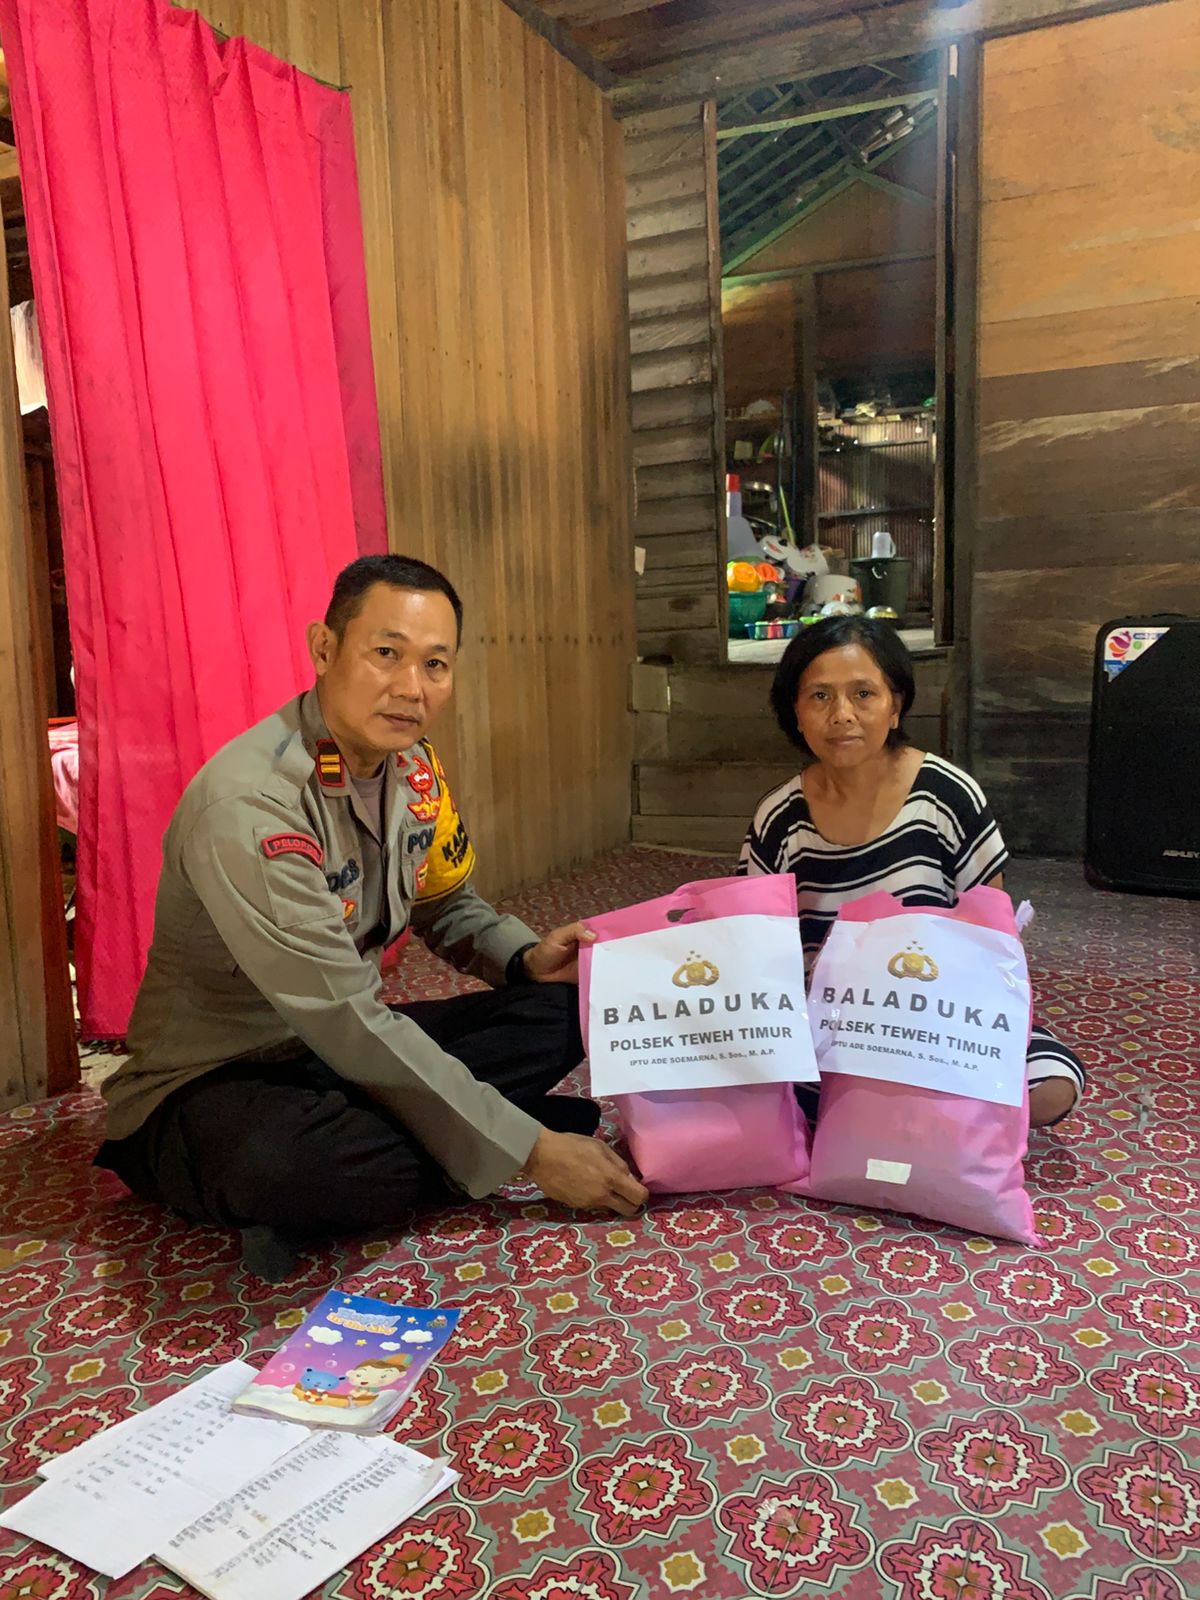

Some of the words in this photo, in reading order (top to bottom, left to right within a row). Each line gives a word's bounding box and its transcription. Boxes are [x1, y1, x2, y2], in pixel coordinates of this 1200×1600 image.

[603, 992, 795, 1025] BALADUKA
[823, 987, 1011, 1032] BALADUKA
[610, 1035, 674, 1052] POLSEK
[679, 1029, 734, 1046] TEWEH
[738, 1026, 793, 1040] TIMUR
[819, 1019, 875, 1035] POLSEK
[880, 1024, 940, 1046] TEWEH
[946, 1036, 1001, 1060] TIMUR
[651, 1057, 667, 1065] ADE
[670, 1054, 718, 1064] SOEMARNA,
[849, 1042, 865, 1050] ADE
[866, 1044, 915, 1059] SOEMARNA,
[917, 1052, 926, 1060] S.
[951, 1059, 961, 1067] M.
[963, 1062, 979, 1071] A.P.
